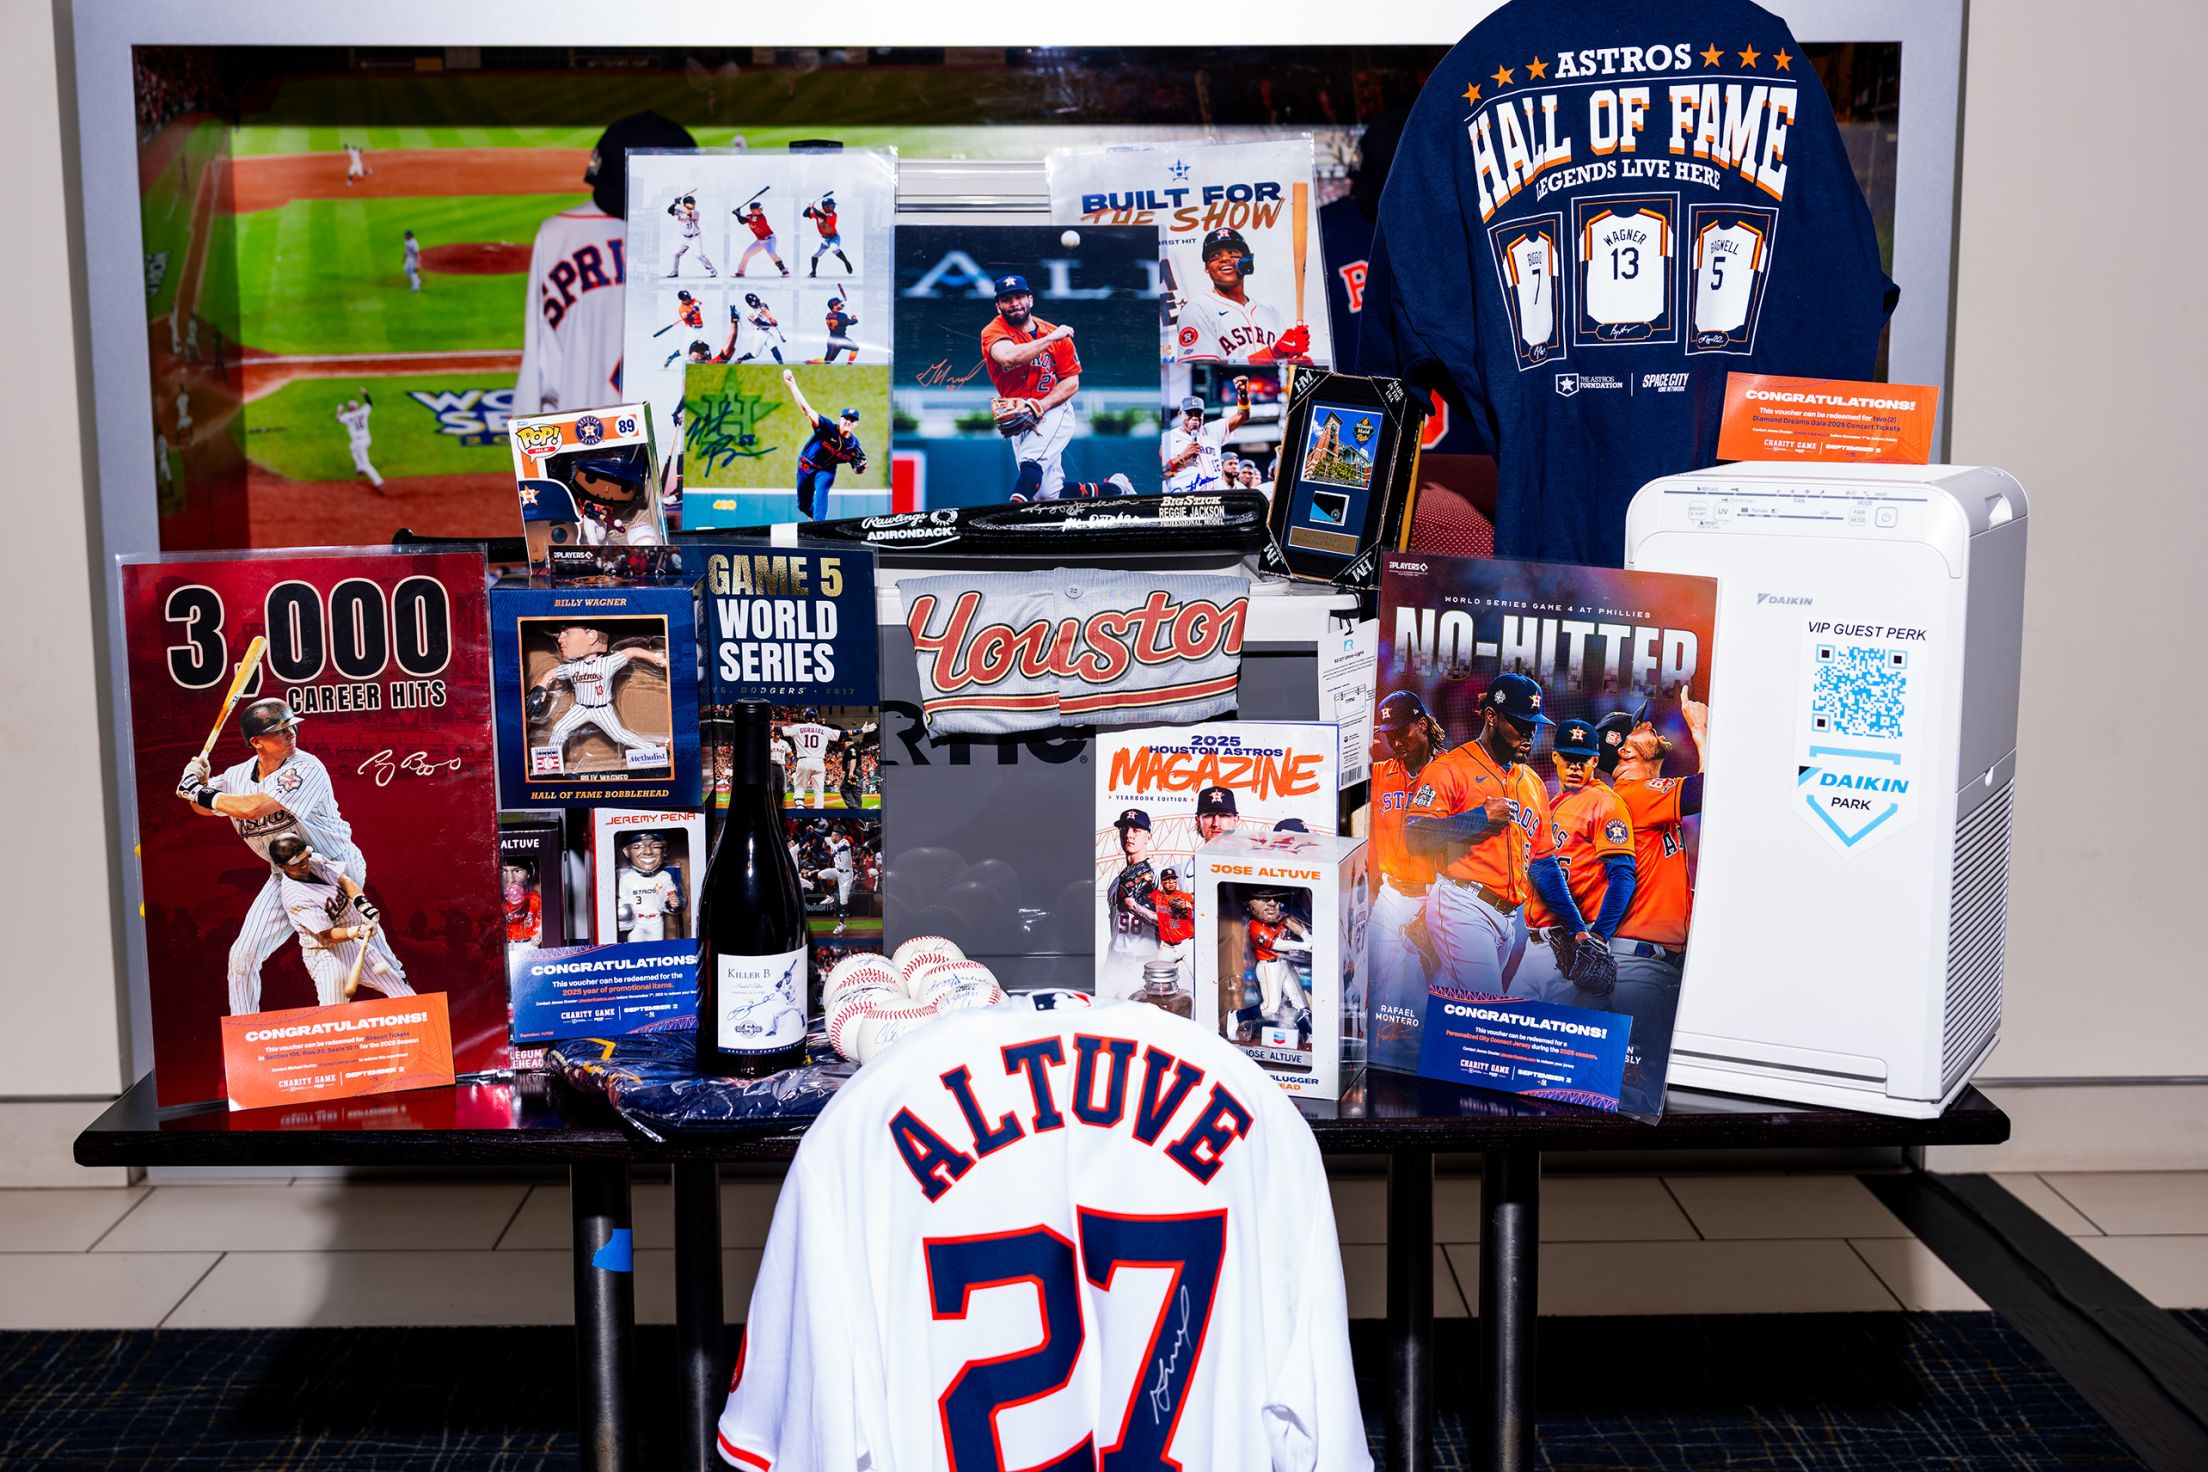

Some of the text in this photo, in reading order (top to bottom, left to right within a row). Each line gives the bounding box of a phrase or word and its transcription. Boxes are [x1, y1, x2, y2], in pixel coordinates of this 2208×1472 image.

[1555, 43, 1692, 79] ASTROS
[1467, 83, 1798, 224] HALL OF FAME
[1536, 158, 1721, 202] LEGENDS LIVE HERE
[1081, 181, 1282, 214] BUILT FOR
[1169, 197, 1285, 232] SHOW
[1603, 229, 1647, 246] WAGNER
[1611, 247, 1640, 280] 13
[1711, 256, 1726, 290] 5
[1532, 269, 1541, 305] 7
[1294, 370, 1313, 393] HM
[1642, 373, 1689, 387] SPACE CITY
[1745, 390, 1916, 411] CONGRATULATIONS!
[1826, 413, 1861, 421] redeemed
[618, 419, 635, 433] 89
[515, 426, 561, 450] POP!
[1764, 439, 1874, 452] CHARITY GAME SEPTEMBER
[1159, 505, 1225, 518] REGGIE JACKSON
[861, 512, 928, 529] Rawlings
[867, 527, 953, 541] ADIRONDACK
[1392, 562, 1420, 570] PLAYERS
[708, 554, 843, 597] GAME 5
[584, 598, 628, 607] WAGNER
[1444, 595, 1652, 619] WORLD SERIES GAME 4 AT PHILLIES
[1768, 595, 1813, 606] DAIKIN
[716, 598, 838, 640] WORLD
[165, 575, 452, 699] 3,000
[1808, 621, 1928, 641] VIP GUEST PERK
[719, 641, 835, 682] SERIES
[1392, 606, 1699, 700] NO-HITTER
[287, 680, 447, 714] CAREER HITS
[741, 687, 806, 695] DODGERS
[804, 734, 819, 748] 10
[1191, 735, 1241, 747] 2025
[629, 753, 666, 762] Methodist
[1149, 745, 1283, 758] HOUSTON ASTROS
[1108, 746, 1325, 801] MAGAZINE
[1820, 772, 1910, 794] DAIKIN
[531, 789, 669, 800] HALL OF FAME BOBBLEHEAD
[1116, 794, 1155, 802] YEARBOOK
[1830, 797, 1872, 811] PARK
[605, 814, 658, 825] JEREMY
[500, 839, 540, 849] ALTUVE
[1211, 864, 1321, 881] JOSE ALTUVE
[636, 896, 642, 904] 3
[1119, 914, 1142, 935] 58
[569, 979, 598, 987] voucher
[624, 974, 659, 983] redeemed
[763, 968, 771, 978] B
[583, 987, 599, 996] year
[609, 984, 651, 993] promotional
[561, 1005, 671, 1019] CHARITY GAME SEPTEMBER
[1380, 1004, 1415, 1018] RAFAEL
[245, 1012, 427, 1041] CONGRATULATIONS!
[1375, 1013, 1419, 1027] MONTERO
[1444, 1004, 1607, 1039] CONGRATULATIONS!
[325, 1037, 355, 1046] redeemed
[1446, 1030, 1478, 1040] Personalized
[1490, 1037, 1512, 1045] Connect
[1512, 1040, 1531, 1049] Jersey
[1531, 1044, 1549, 1053] during
[1487, 1029, 1508, 1037] voucher
[1527, 1036, 1554, 1044] redeemed
[1270, 1052, 1302, 1063] ALTUVE
[279, 1067, 396, 1087] CHARITY GAME SEPTEMBER
[1460, 1059, 1565, 1082] CHARITY GAME SEPTEMBER
[888, 1033, 1254, 1203] ALTUVE
[922, 1204, 1229, 1472] 27
